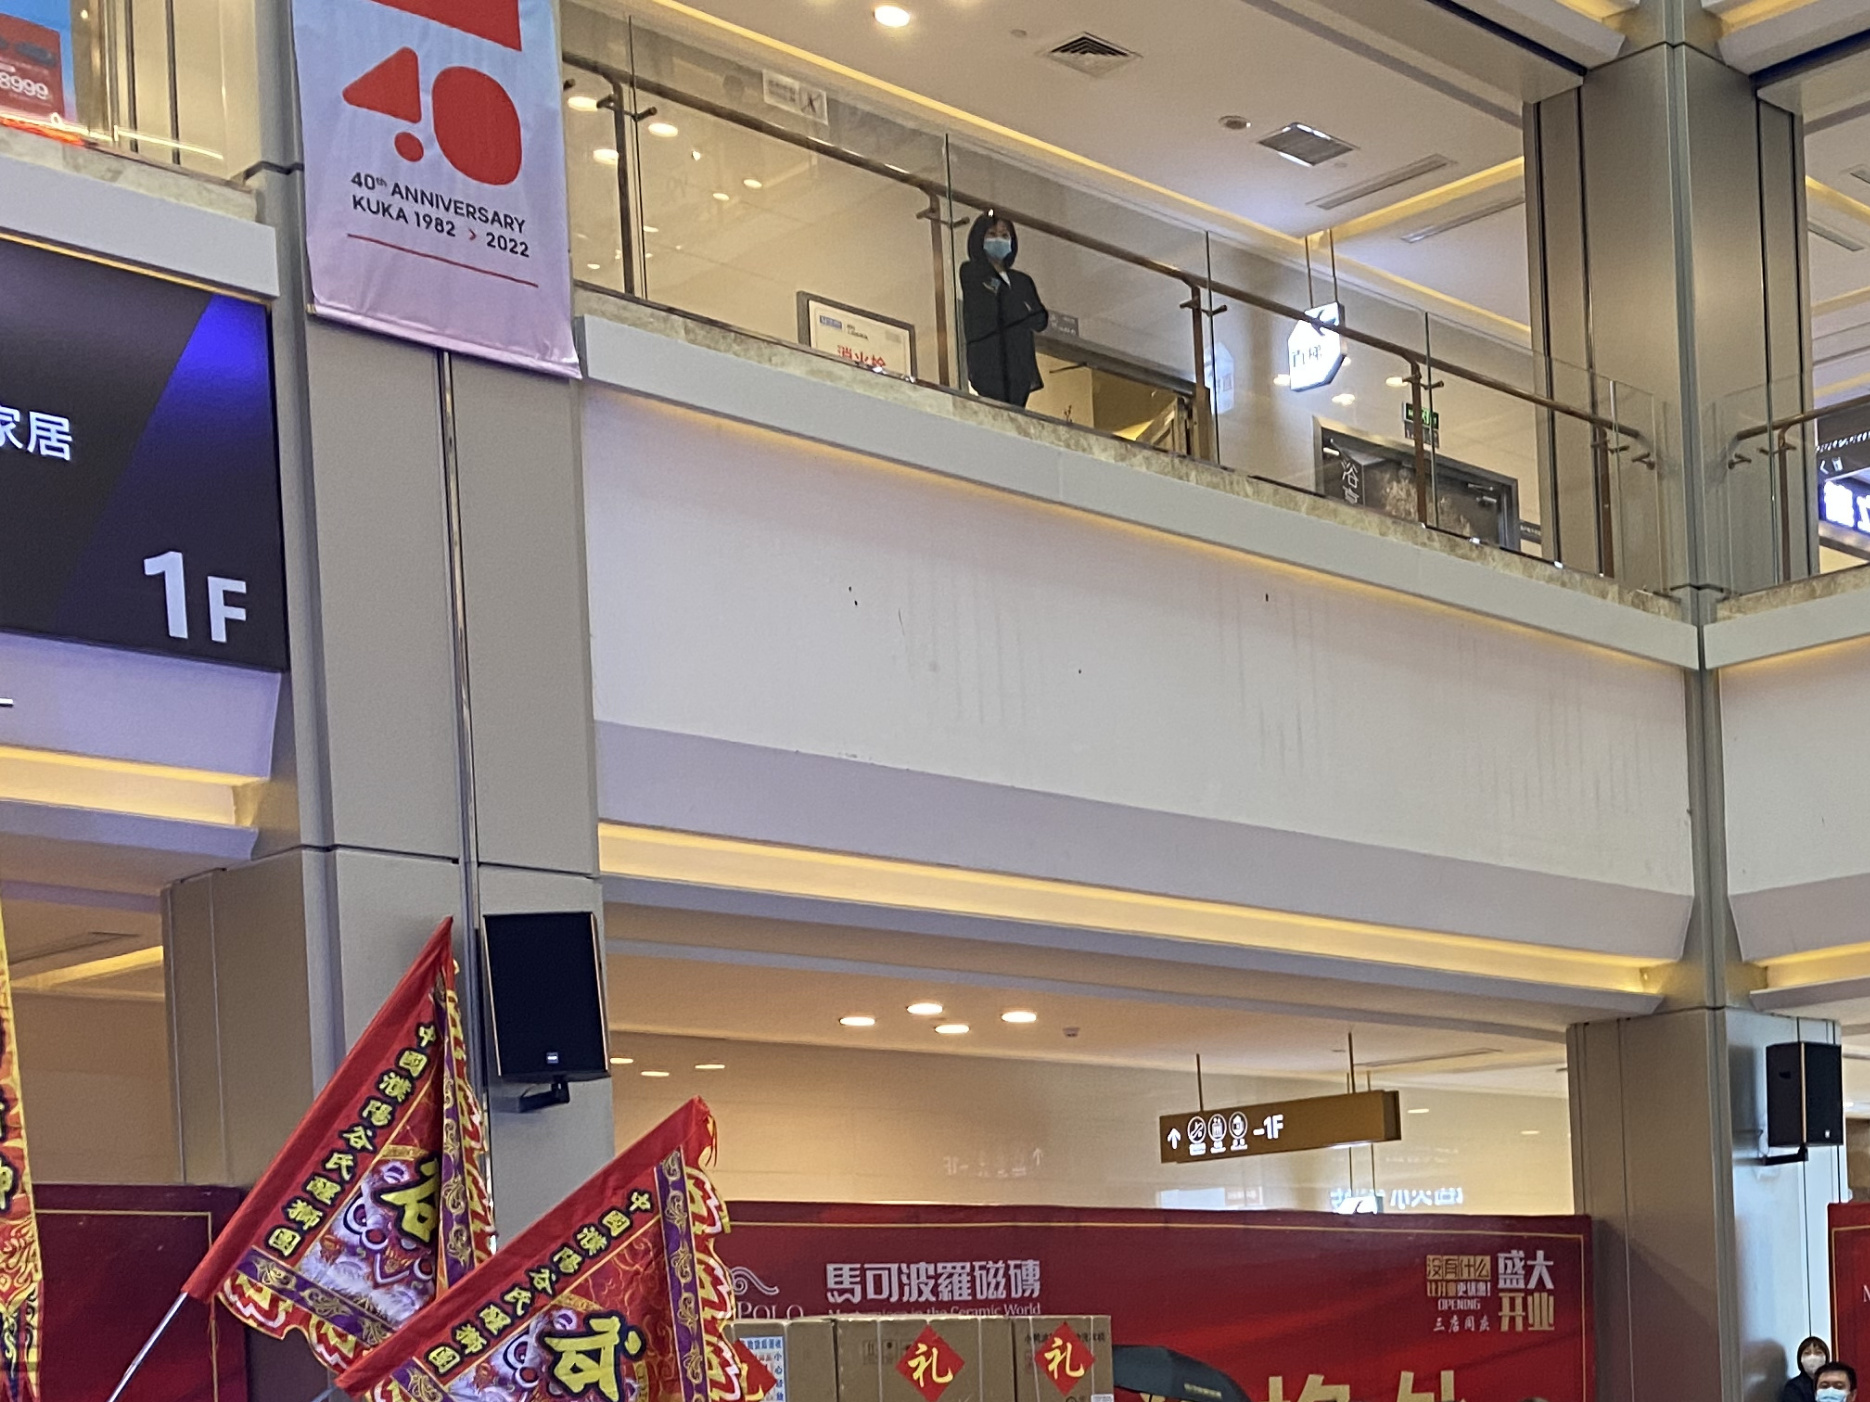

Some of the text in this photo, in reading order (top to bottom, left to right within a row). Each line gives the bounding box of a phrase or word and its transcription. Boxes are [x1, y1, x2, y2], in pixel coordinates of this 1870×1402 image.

[352, 194, 530, 259] KUKA 1982 2022
[391, 182, 526, 234] ANNIVERSARY
[144, 551, 247, 643] 1F
[1438, 1298, 1481, 1311] OPENING
[908, 1343, 954, 1388] 礼
[1044, 1337, 1085, 1380] 礼
